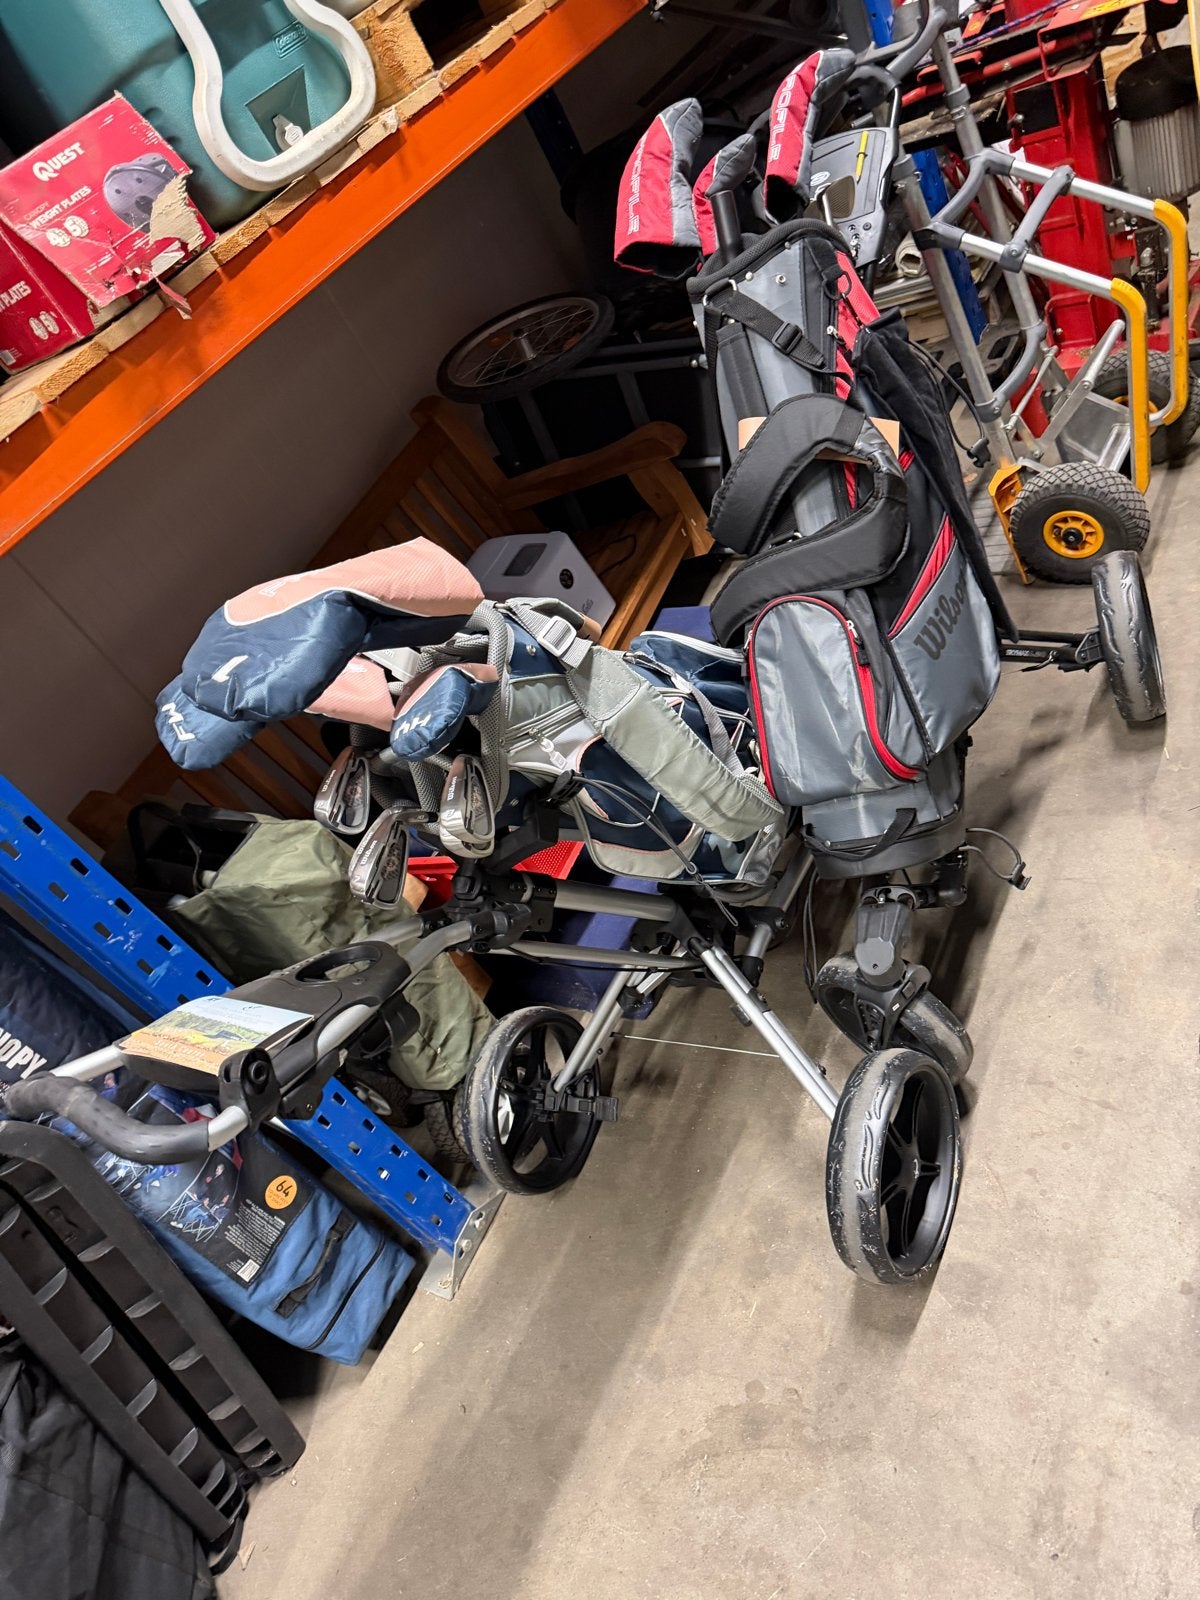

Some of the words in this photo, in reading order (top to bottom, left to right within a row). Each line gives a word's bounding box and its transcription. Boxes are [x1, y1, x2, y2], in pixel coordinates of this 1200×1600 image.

[29, 203, 62, 229] WEIGHT
[60, 185, 92, 209] PLATES
[0, 281, 32, 307] PLATES
[276, 1180, 293, 1197] 64
